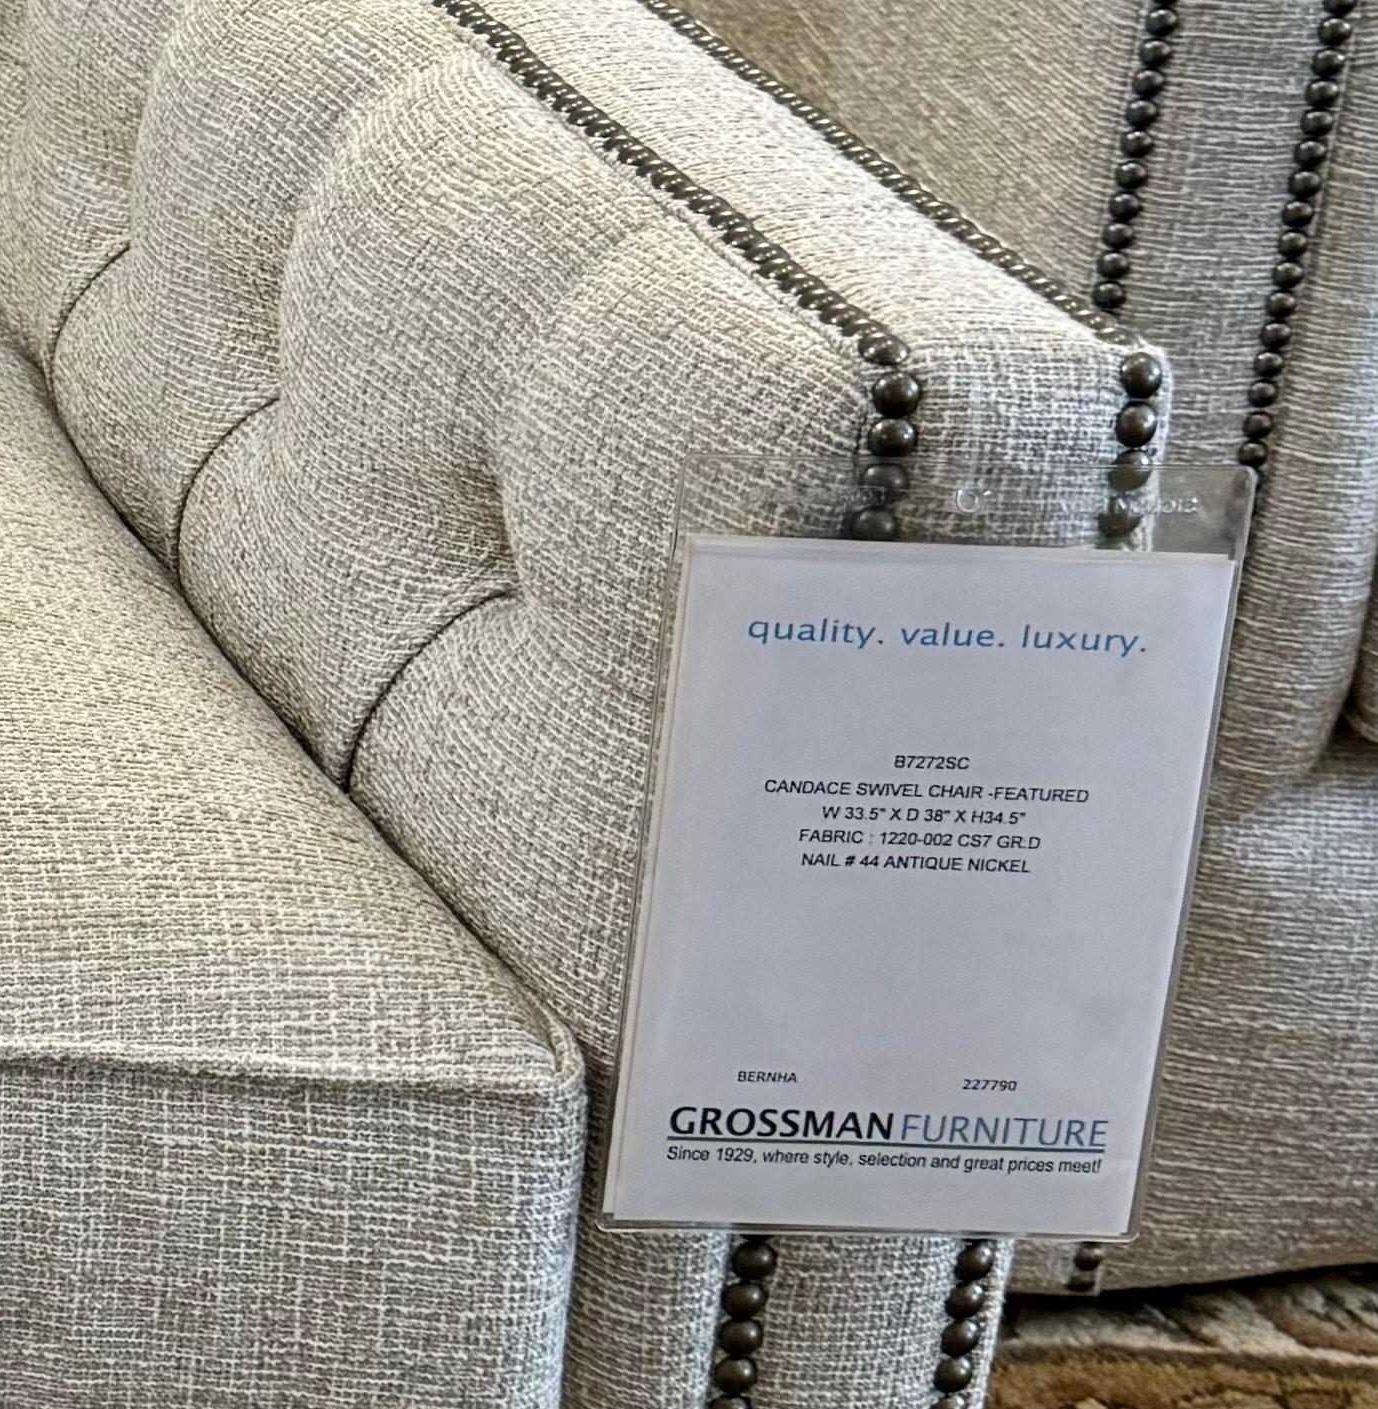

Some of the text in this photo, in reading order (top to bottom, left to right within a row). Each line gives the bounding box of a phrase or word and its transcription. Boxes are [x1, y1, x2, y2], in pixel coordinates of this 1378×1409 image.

[748, 618, 1146, 658] quality. value. luxury.
[894, 754, 970, 770] B7272SC
[764, 779, 1090, 803] CANDACE SWIVEL CHAIR -FEATURED
[822, 805, 1026, 825] W 33.5" X D 38" X H34.5"
[799, 828, 865, 844] FABRIC
[879, 831, 953, 846] 1220-002
[957, 833, 993, 847] CS7
[801, 853, 1032, 873] NAIL # 44 ANTIQUE NICKEL
[737, 1070, 798, 1083] BERNHA
[961, 1078, 1018, 1092] 227790
[669, 1105, 1109, 1148] GROSSMAN FURNITURE
[666, 1145, 710, 1161] Since
[762, 1149, 809, 1164] where
[858, 1152, 926, 1168] selection
[930, 1154, 961, 1169] and
[962, 1156, 1004, 1173] great
[1007, 1158, 1054, 1174] prices
[1058, 1158, 1102, 1173] meet!
